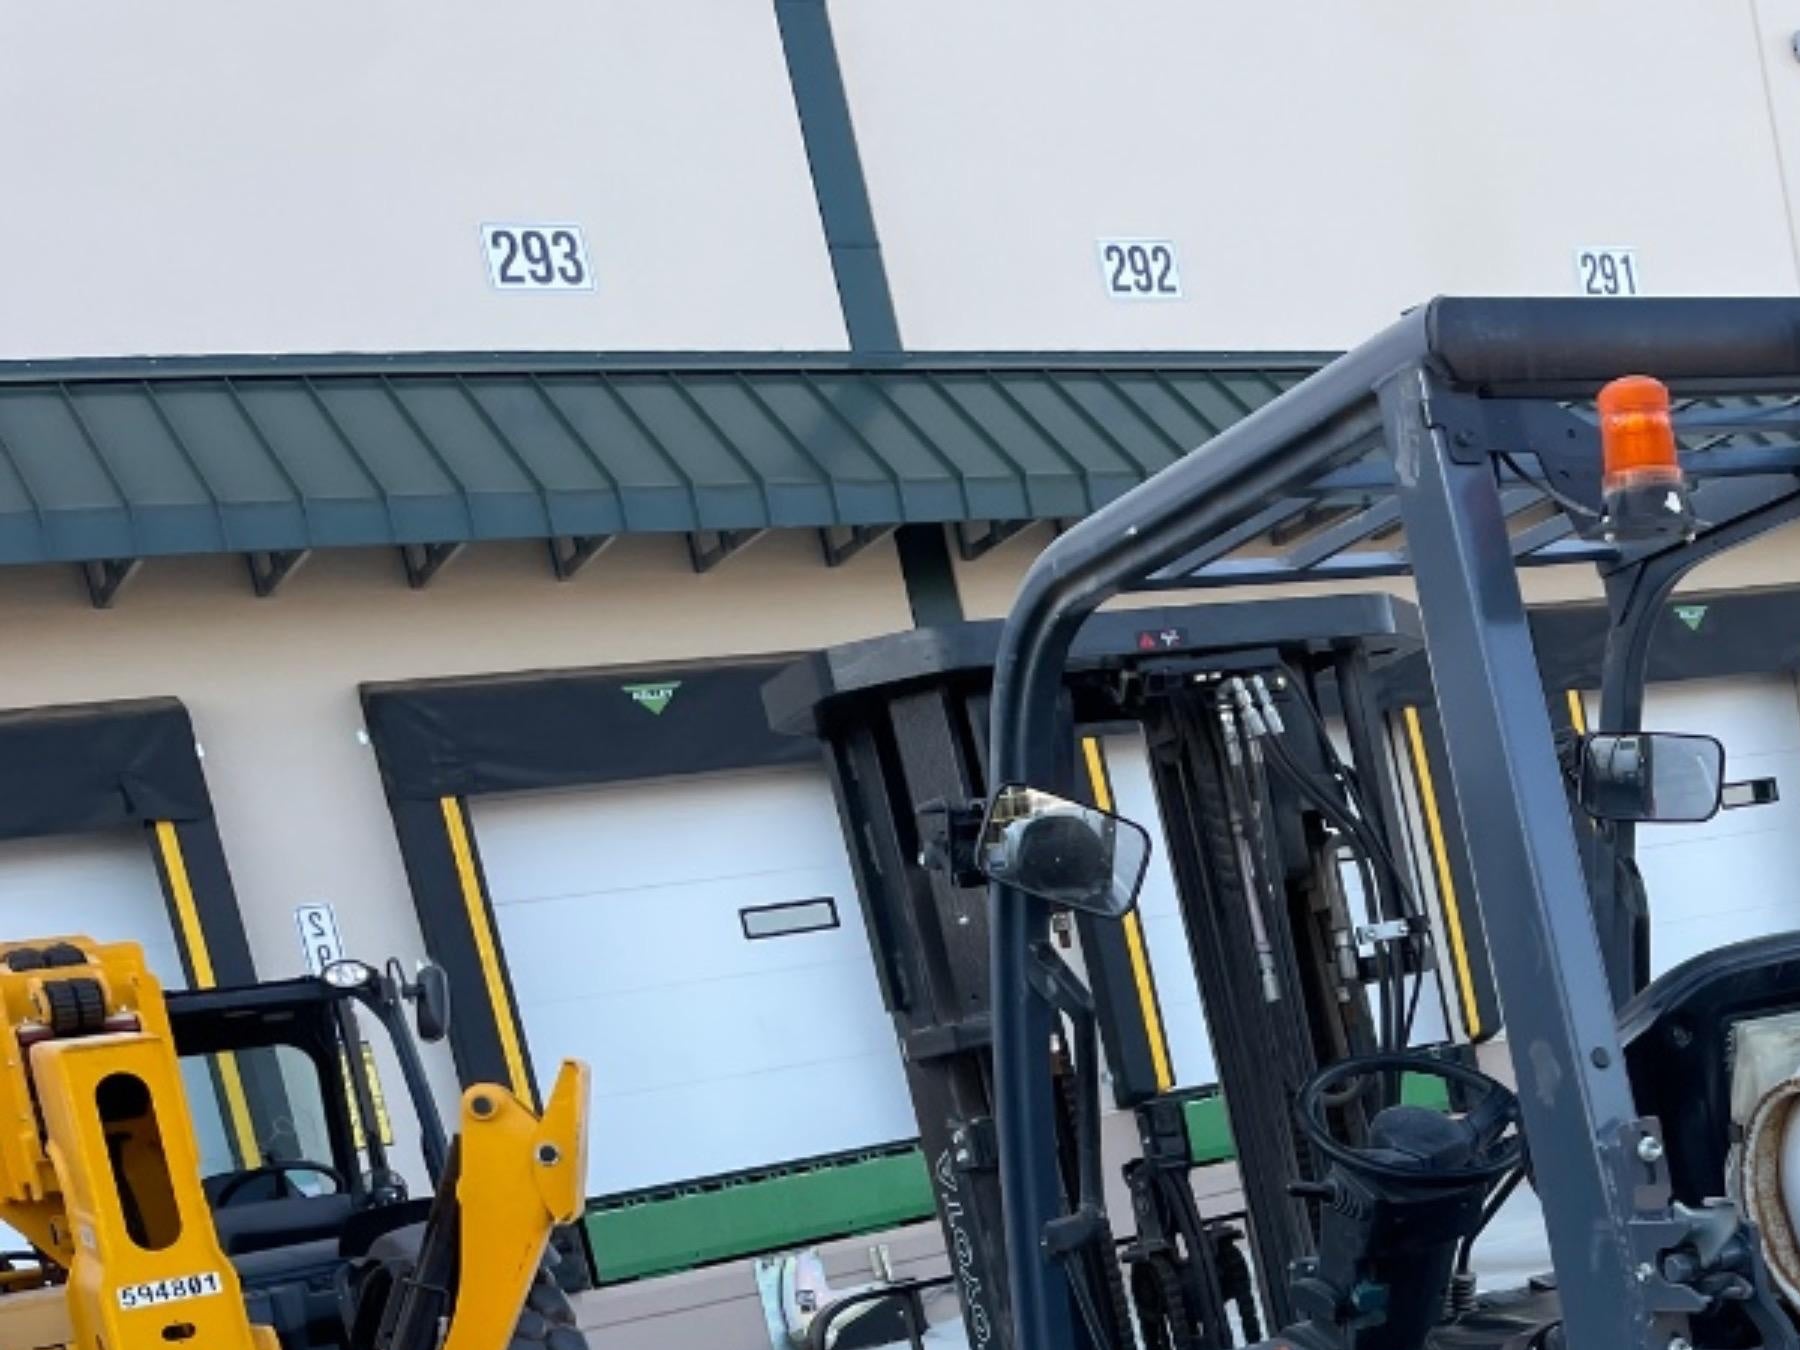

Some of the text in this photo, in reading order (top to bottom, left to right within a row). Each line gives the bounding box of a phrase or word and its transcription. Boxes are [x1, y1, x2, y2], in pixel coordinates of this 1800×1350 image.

[491, 230, 585, 286] 293
[1105, 245, 1177, 293] 292
[1580, 252, 1636, 295] 291
[122, 1273, 217, 1306] 594801
